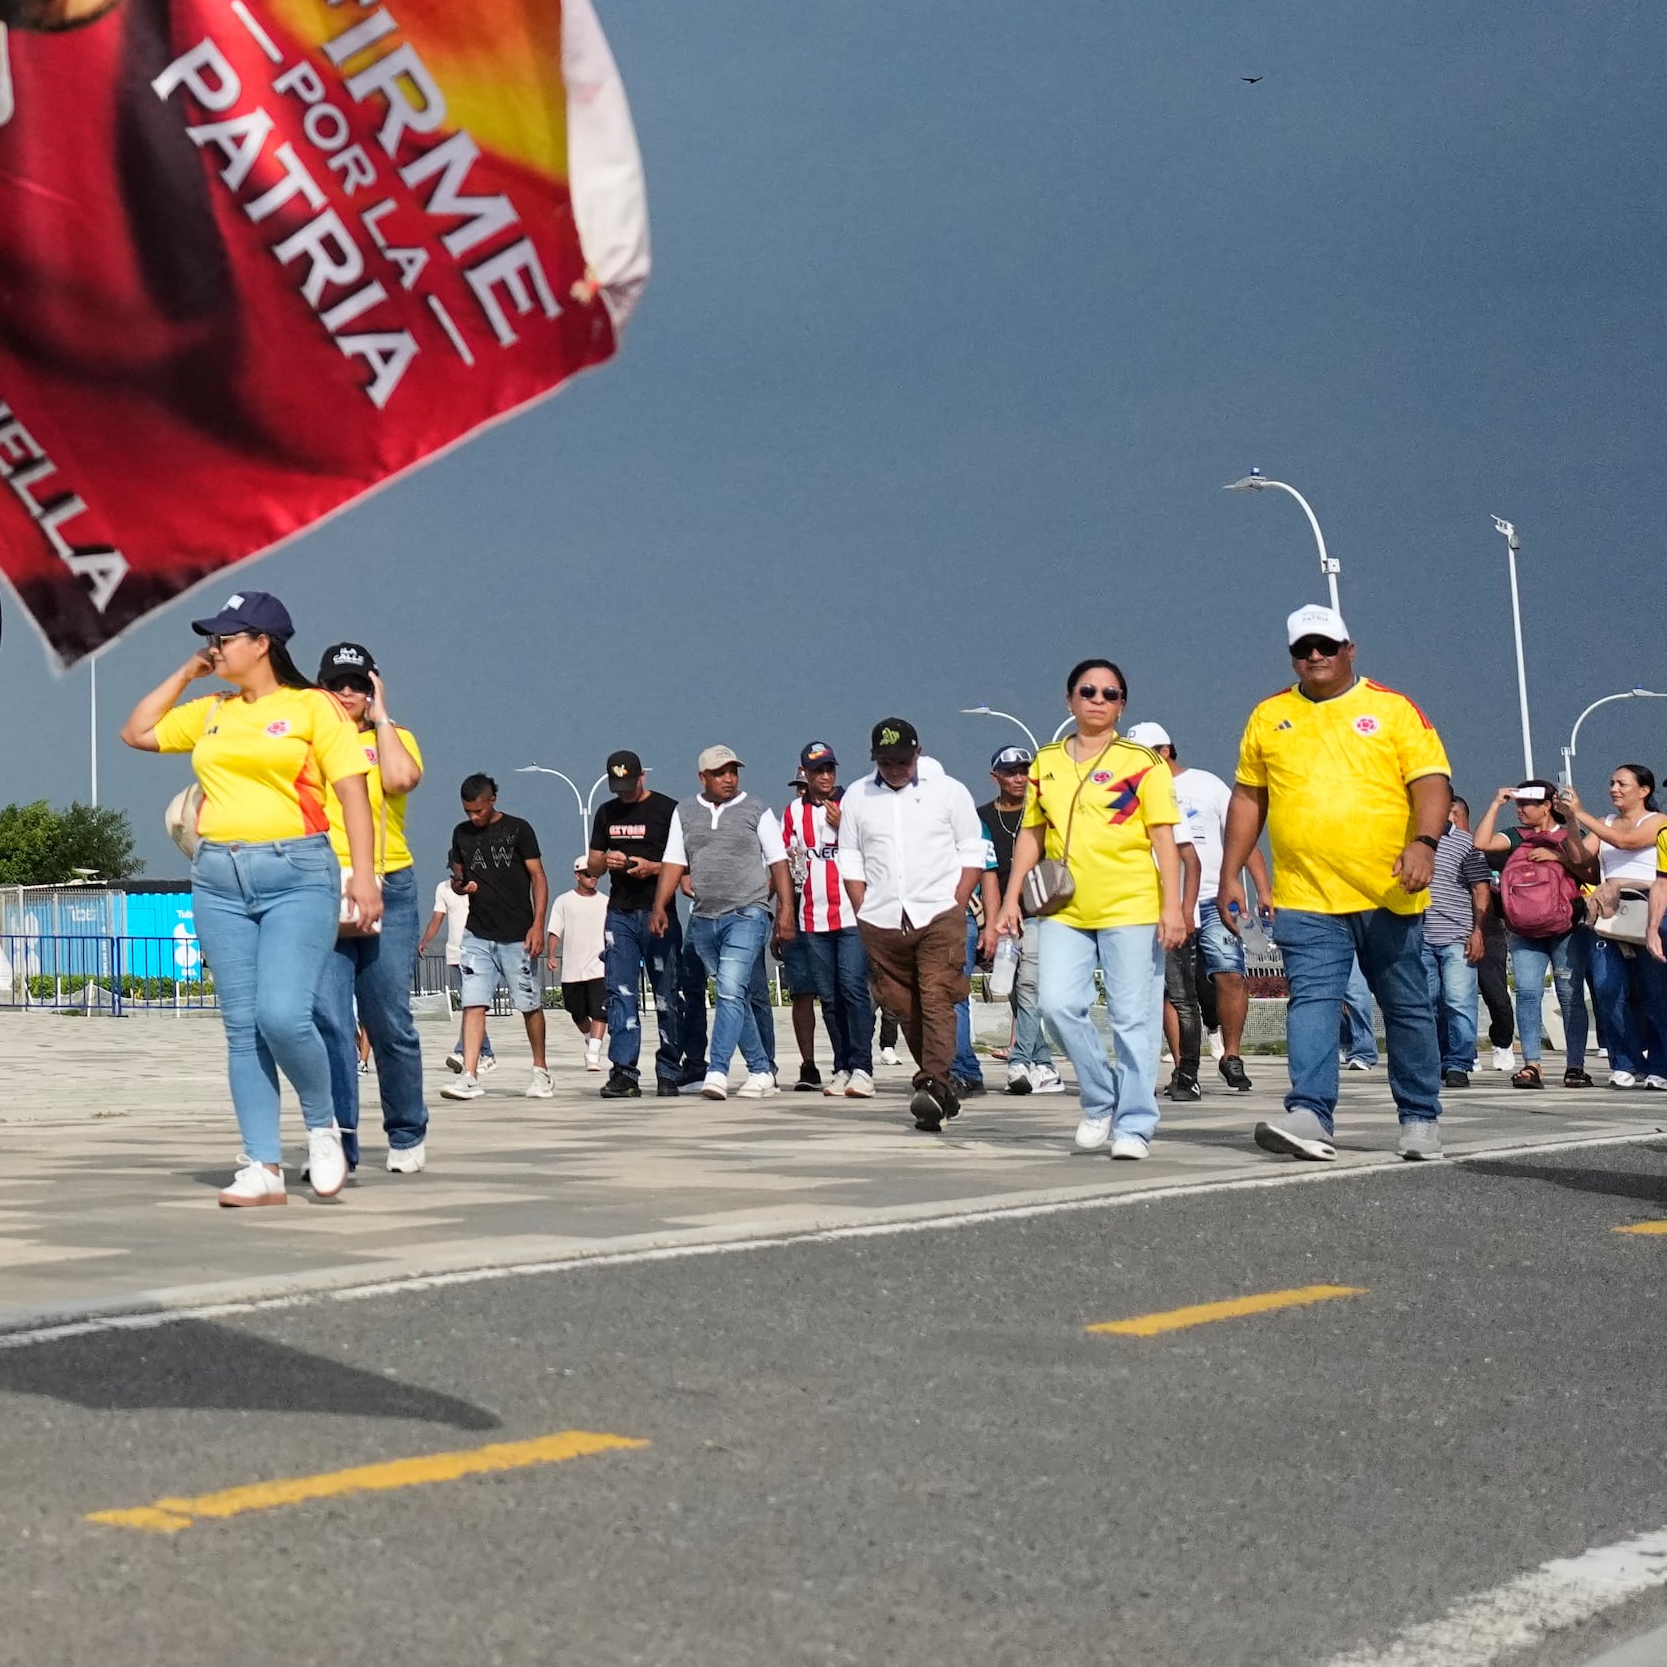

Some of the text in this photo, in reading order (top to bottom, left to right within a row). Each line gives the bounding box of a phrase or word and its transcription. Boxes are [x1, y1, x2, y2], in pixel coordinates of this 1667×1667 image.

[150, 37, 420, 409] PATRIA
[272, 60, 431, 290] POR LA
